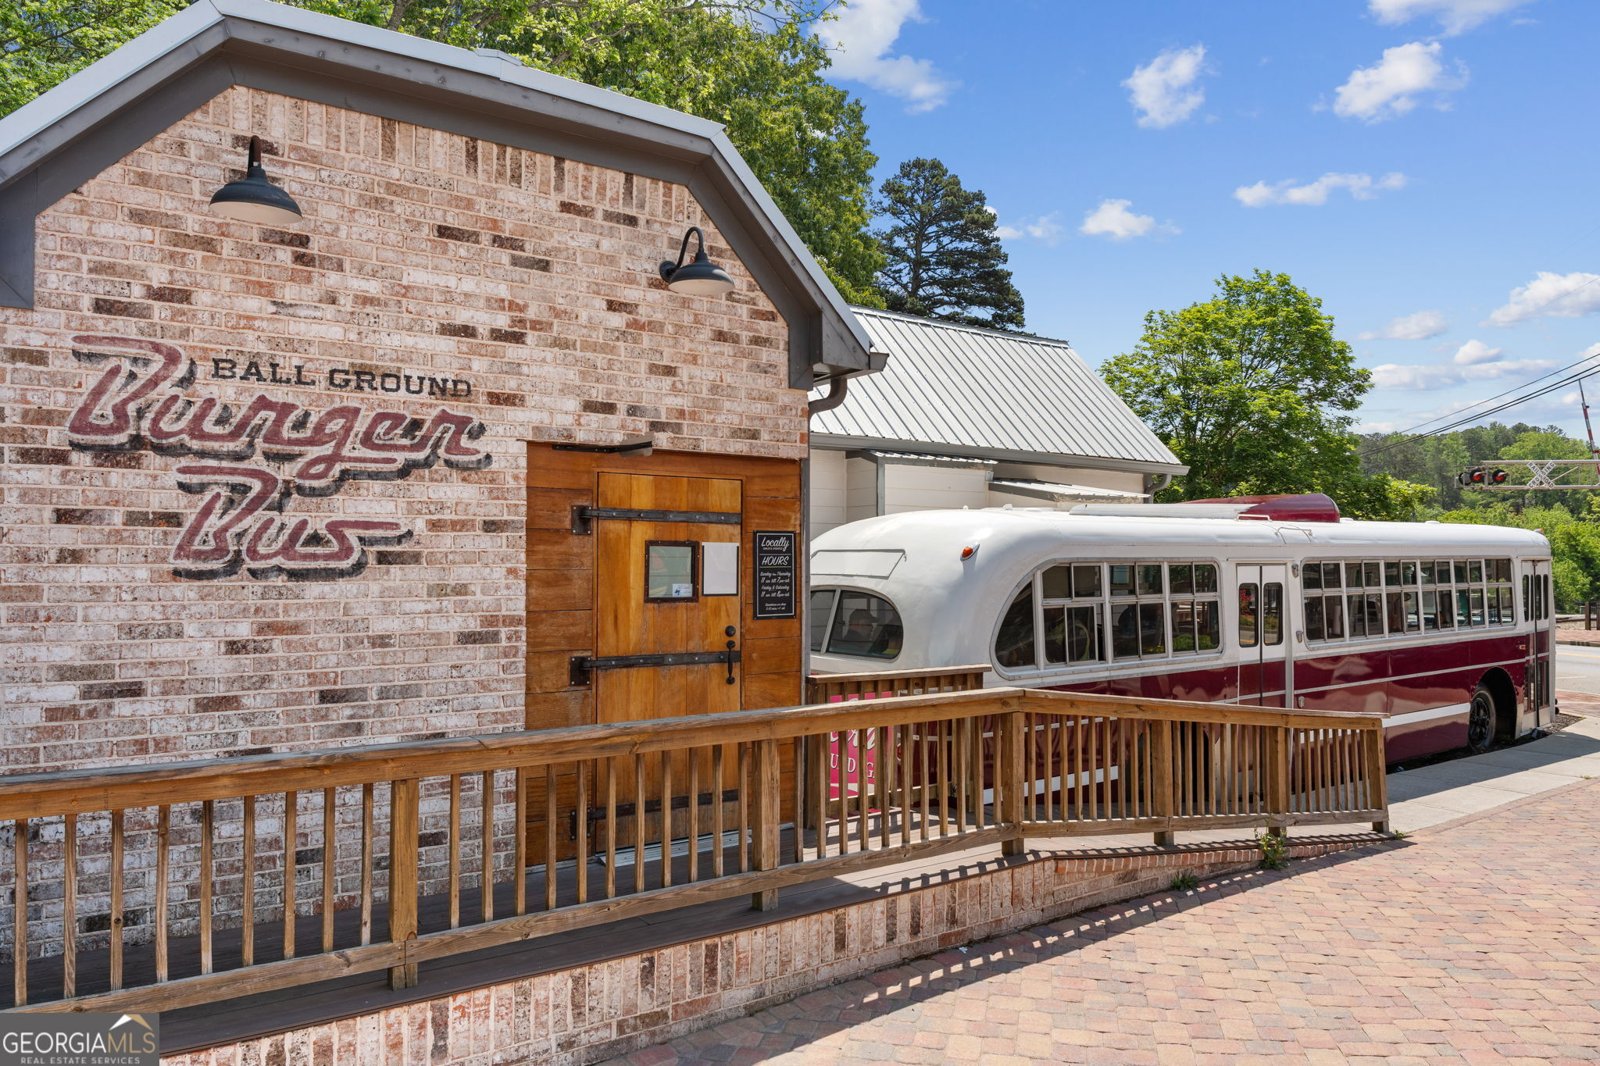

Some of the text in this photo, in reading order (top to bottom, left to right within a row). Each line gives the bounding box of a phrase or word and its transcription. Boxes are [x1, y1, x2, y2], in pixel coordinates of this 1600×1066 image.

[211, 358, 472, 398] BALL GROUND
[68, 335, 488, 490] Burger
[174, 465, 408, 571] Bus
[761, 536, 790, 552] Locally
[761, 555, 790, 566] HOURS
